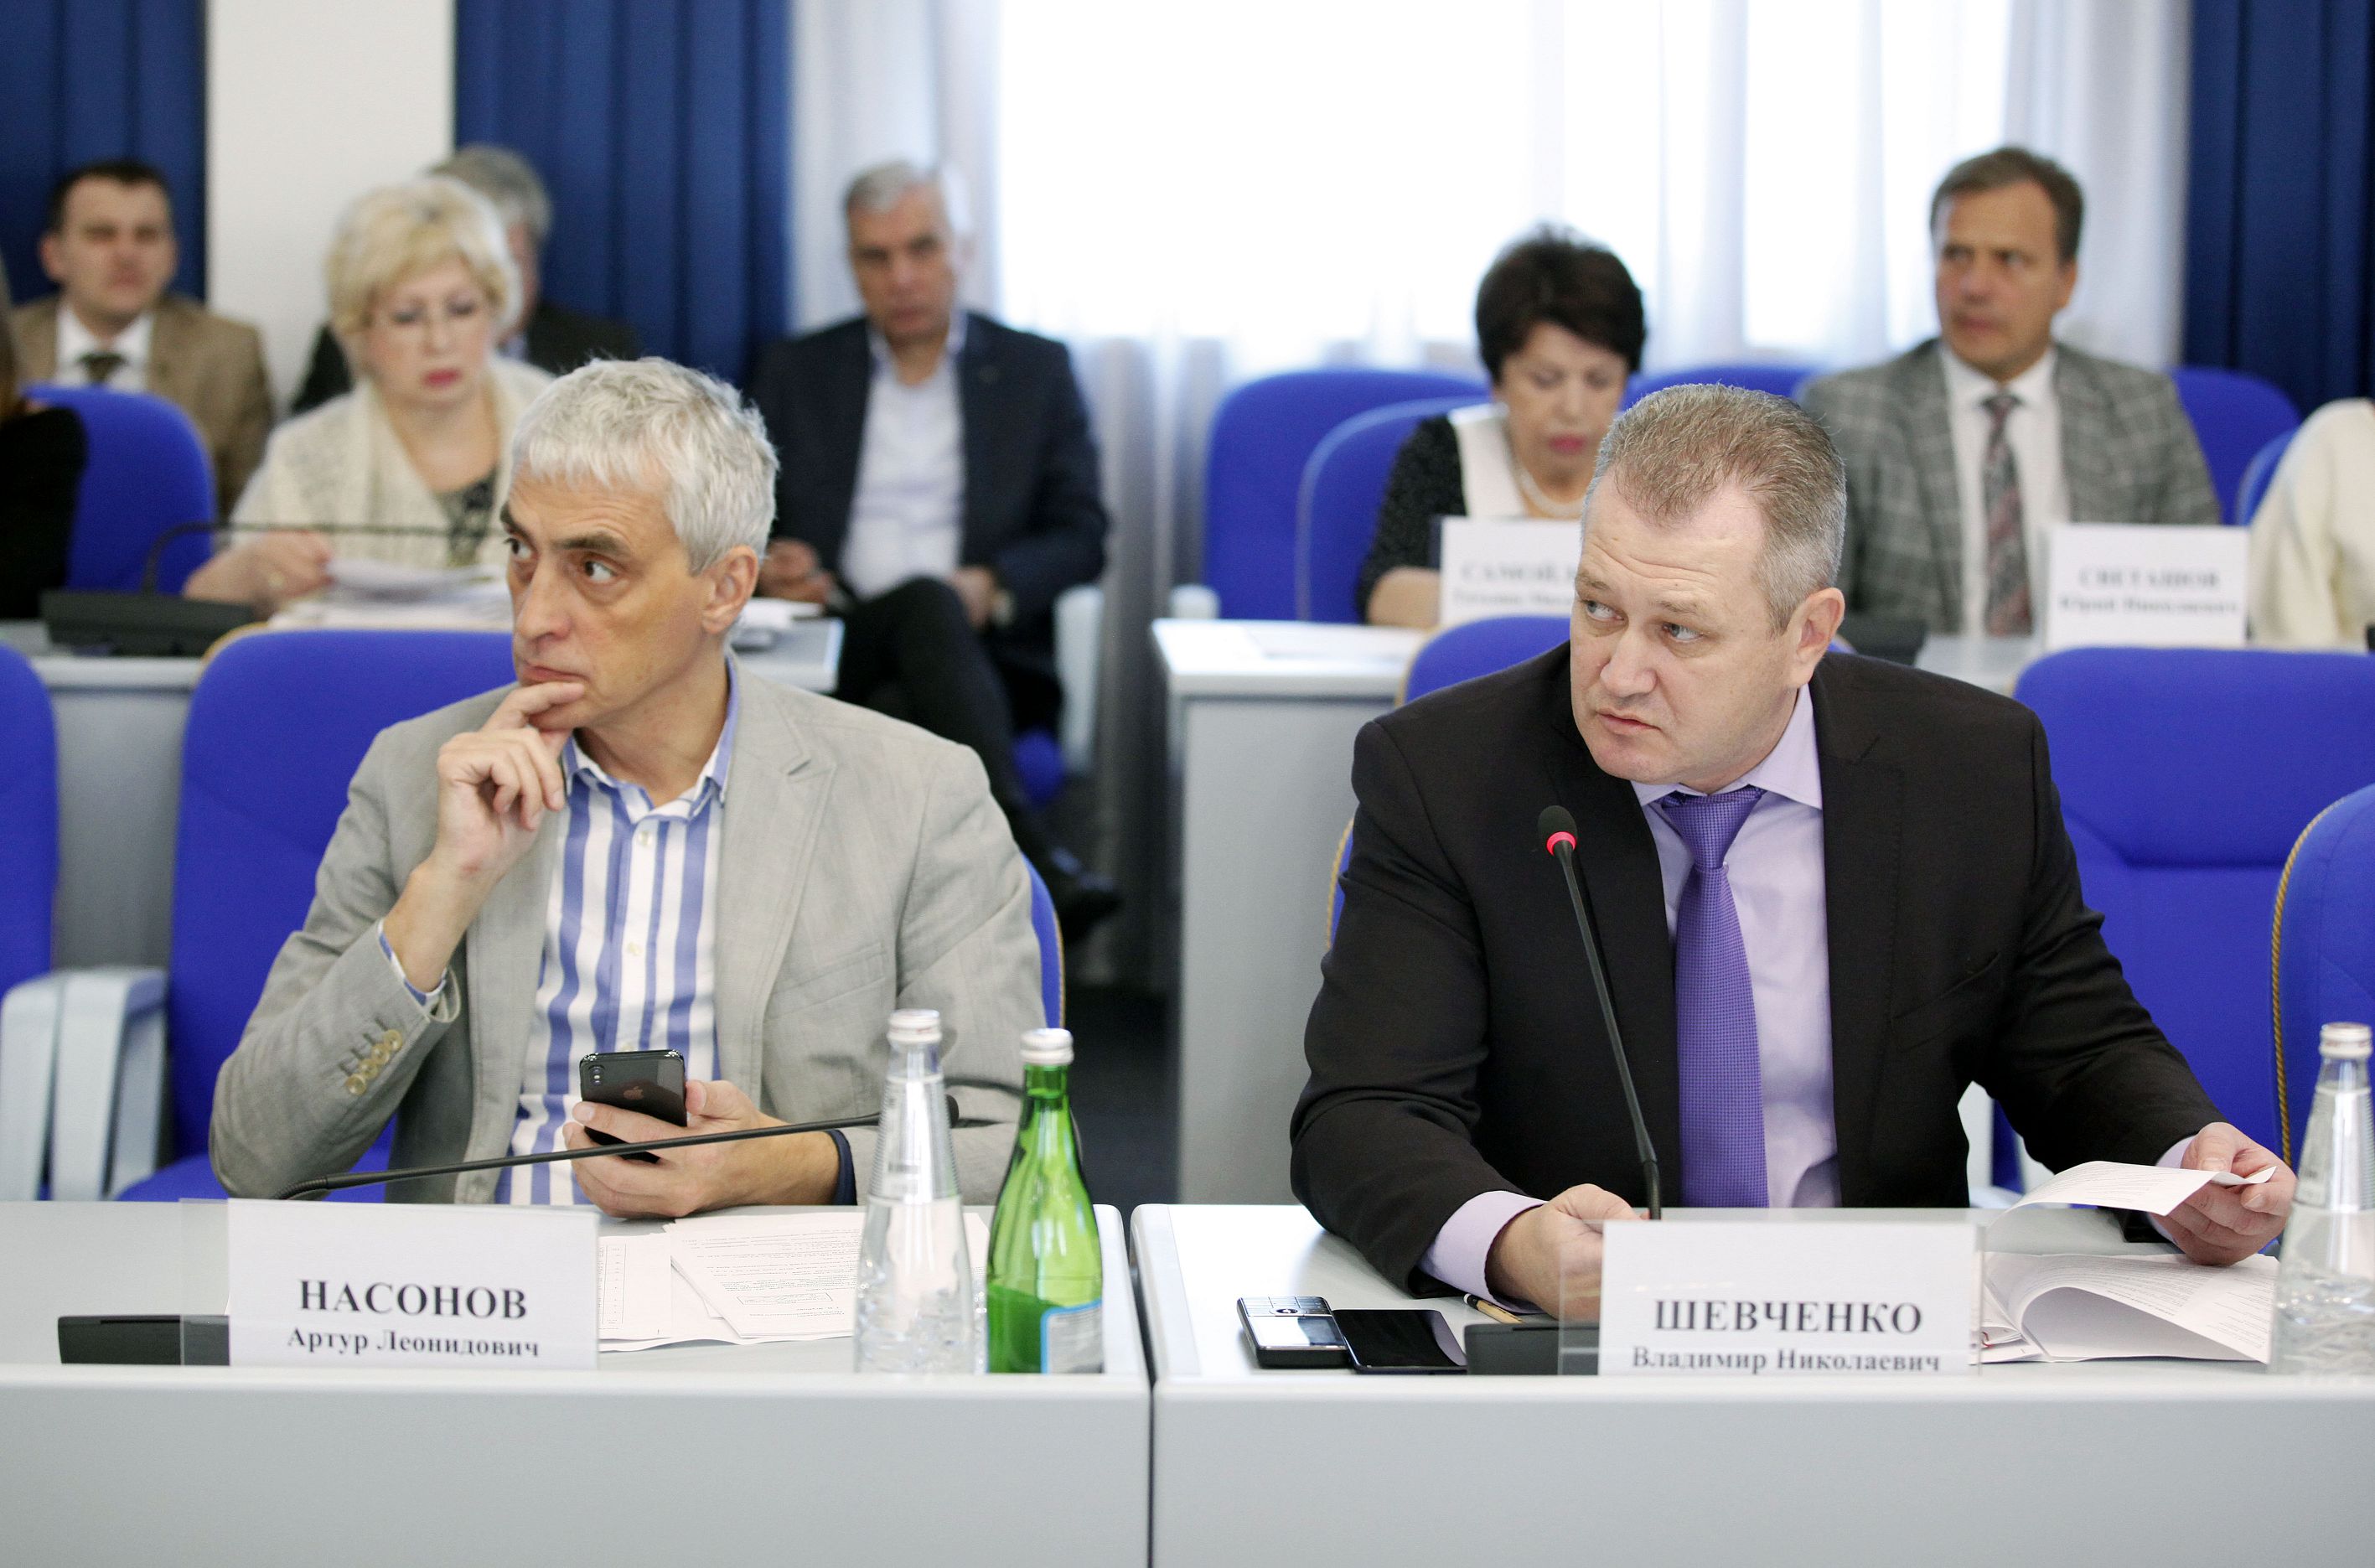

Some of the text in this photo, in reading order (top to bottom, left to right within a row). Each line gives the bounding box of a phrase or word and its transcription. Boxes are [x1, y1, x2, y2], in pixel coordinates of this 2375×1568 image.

[299, 1279, 527, 1319] НАСОНОВ
[1653, 1299, 1922, 1333] ШЕВЧЕНКО
[287, 1327, 540, 1357] Артур Леонидович
[1632, 1346, 1940, 1374] Владимир Николаевич
